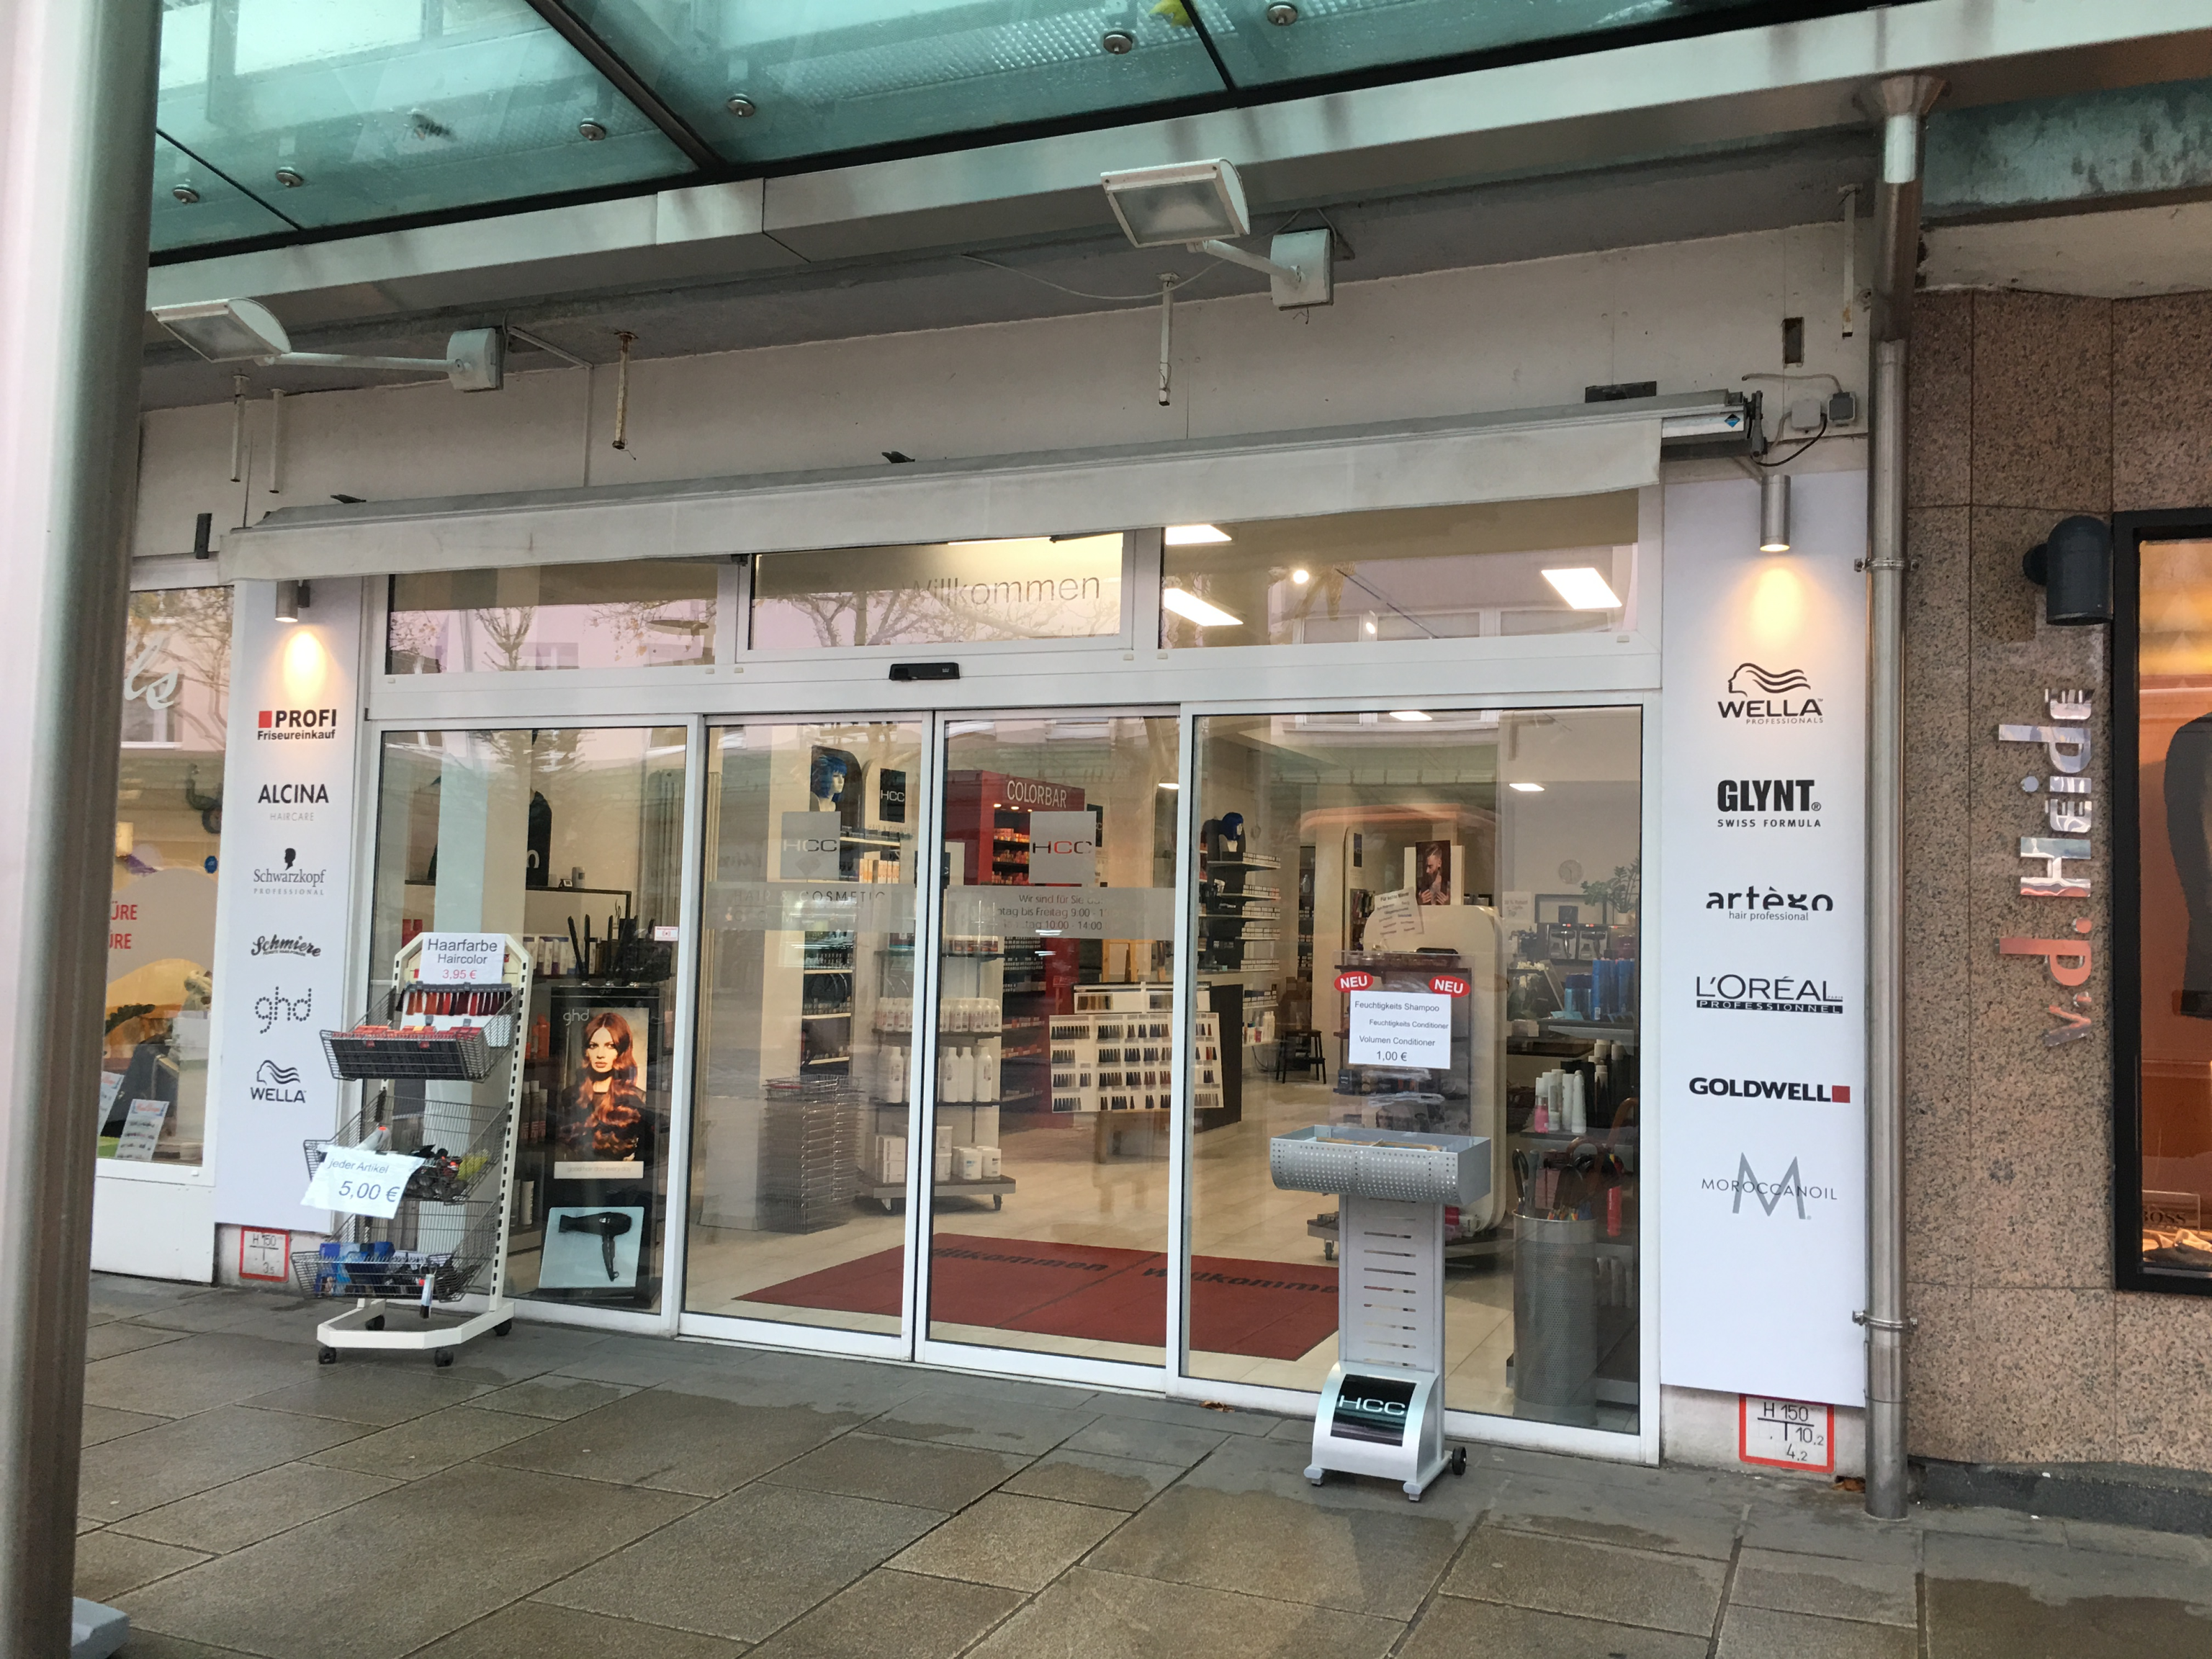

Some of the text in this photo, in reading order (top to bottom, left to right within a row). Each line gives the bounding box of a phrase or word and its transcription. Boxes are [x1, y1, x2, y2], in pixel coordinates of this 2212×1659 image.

[275, 709, 337, 728] PROFI
[257, 729, 336, 740] Friseureinkauf
[258, 784, 329, 804] ALCINA
[881, 789, 905, 802] HCC
[1007, 780, 1067, 809] COLORBAR
[270, 812, 315, 822] HAIRCARE
[1717, 819, 1822, 828] SWISS FORMULA
[783, 839, 837, 853] HCC
[1032, 840, 1092, 855] HCC
[253, 868, 327, 888] Schwarzkopf
[734, 891, 770, 902] HAIR
[781, 891, 788, 902] &
[1019, 894, 1033, 903] Wir
[1035, 894, 1054, 904] sind
[1056, 894, 1069, 904] für
[1071, 895, 1084, 904] Sie
[1021, 907, 1035, 917] bis
[1035, 907, 1069, 919] Freitag
[1071, 908, 1091, 917] 9:00
[1728, 910, 1809, 922] hair professional
[1045, 920, 1069, 930] 10:00
[1078, 921, 1102, 930] 14:00
[251, 934, 321, 957] Schmiere
[427, 938, 498, 952] Haarfarbe
[437, 953, 488, 965] Haircolor
[442, 969, 477, 980] 3,95 €
[1340, 975, 1368, 989] NEU
[1434, 979, 1464, 994] NEU
[255, 986, 313, 1035] ghd
[1354, 1000, 1440, 1013] Feuchtigkeits Shampoo
[1698, 999, 1841, 1014] PROFESSIONNEL
[562, 1008, 590, 1026] ghd
[1369, 1019, 1449, 1030] Feuchtigkeits Conditioner
[1359, 1035, 1436, 1046] Volumen Conditioner
[1376, 1051, 1408, 1061] 1,00 €
[1689, 1077, 1832, 1102] GOLDWELL
[327, 1159, 390, 1174] jeder Artikel
[338, 1180, 400, 1203] 5,00 €
[1701, 1177, 1838, 1201] MOROCCANOIL
[252, 1233, 277, 1246] H 150
[1339, 1395, 1406, 1416] HCC
[1763, 1401, 1809, 1422] H 150
[1795, 1426, 1825, 1447] 10.2
[1786, 1443, 1808, 1462] 4.2
